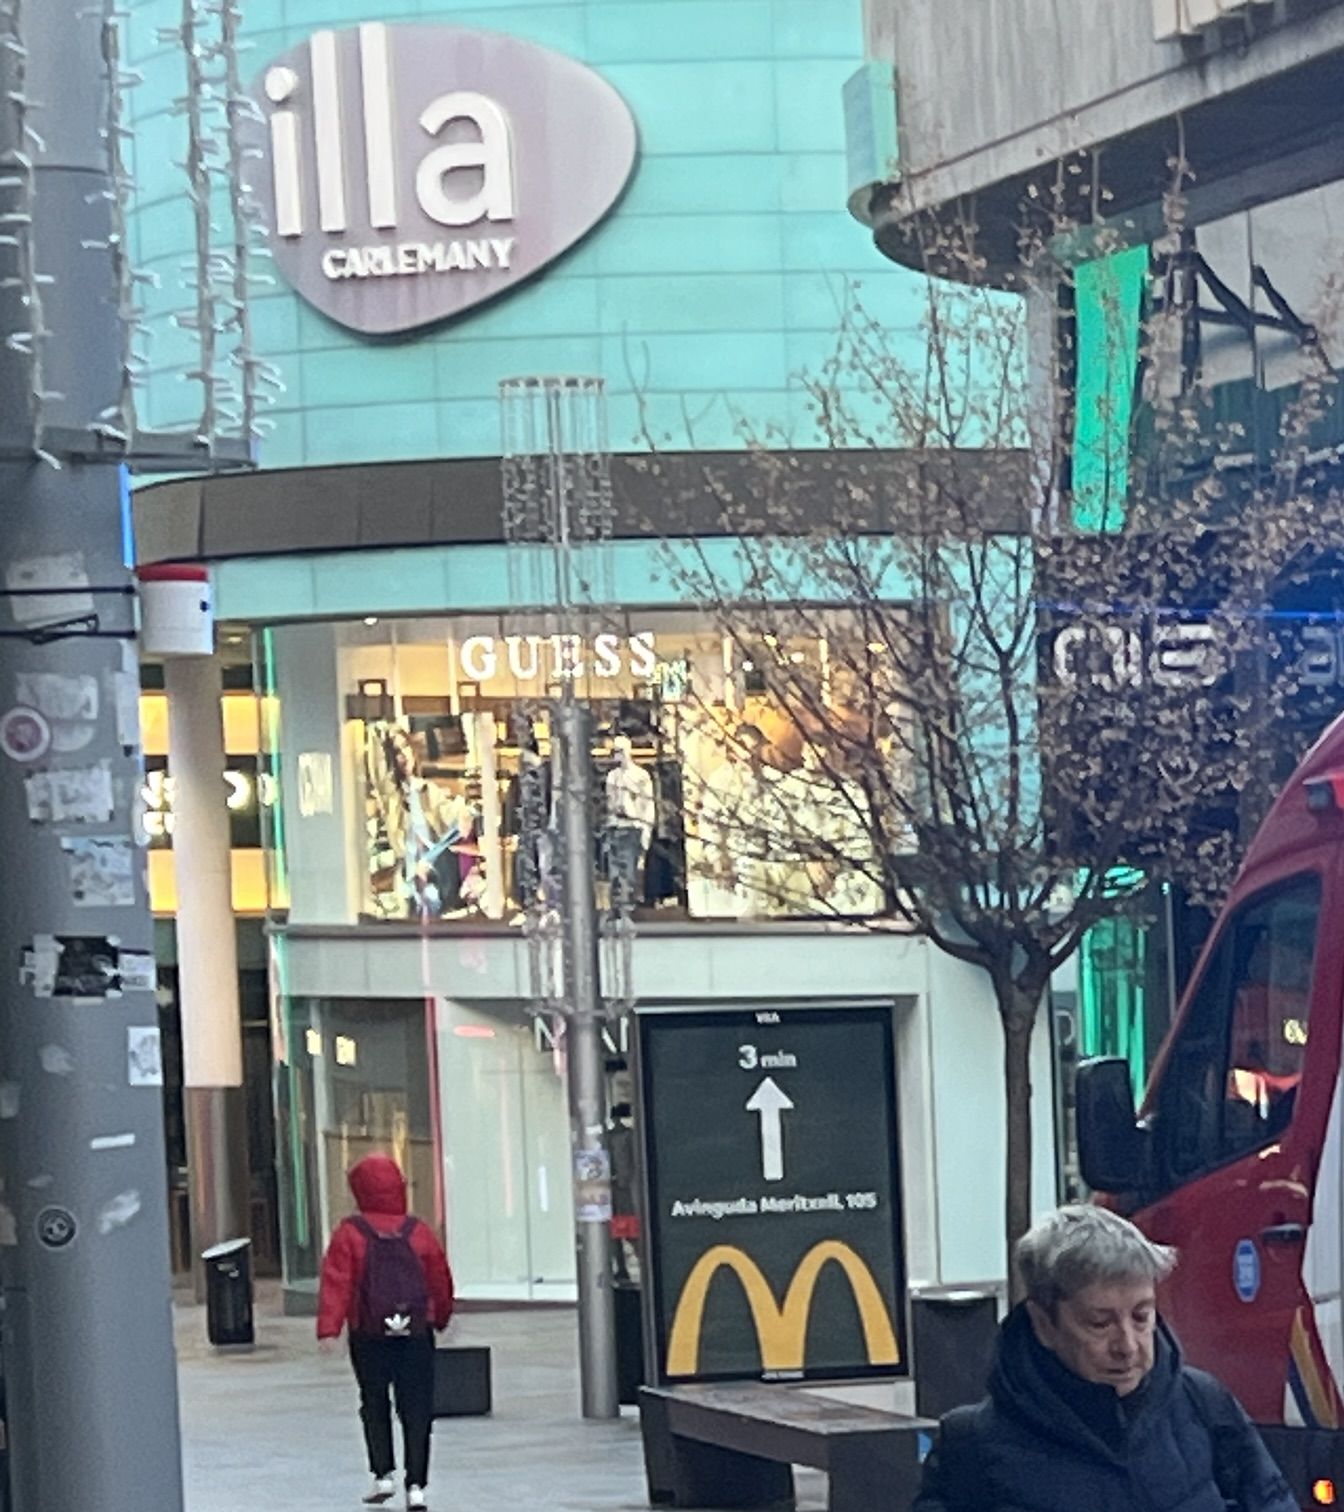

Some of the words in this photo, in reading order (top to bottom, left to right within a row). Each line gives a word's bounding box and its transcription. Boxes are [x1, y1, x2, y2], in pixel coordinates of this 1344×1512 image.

[264, 20, 516, 237] illa
[321, 237, 516, 281] CARLEMANY
[460, 632, 656, 681] GUESS
[738, 1045, 757, 1070] 3
[760, 1050, 797, 1068] min
